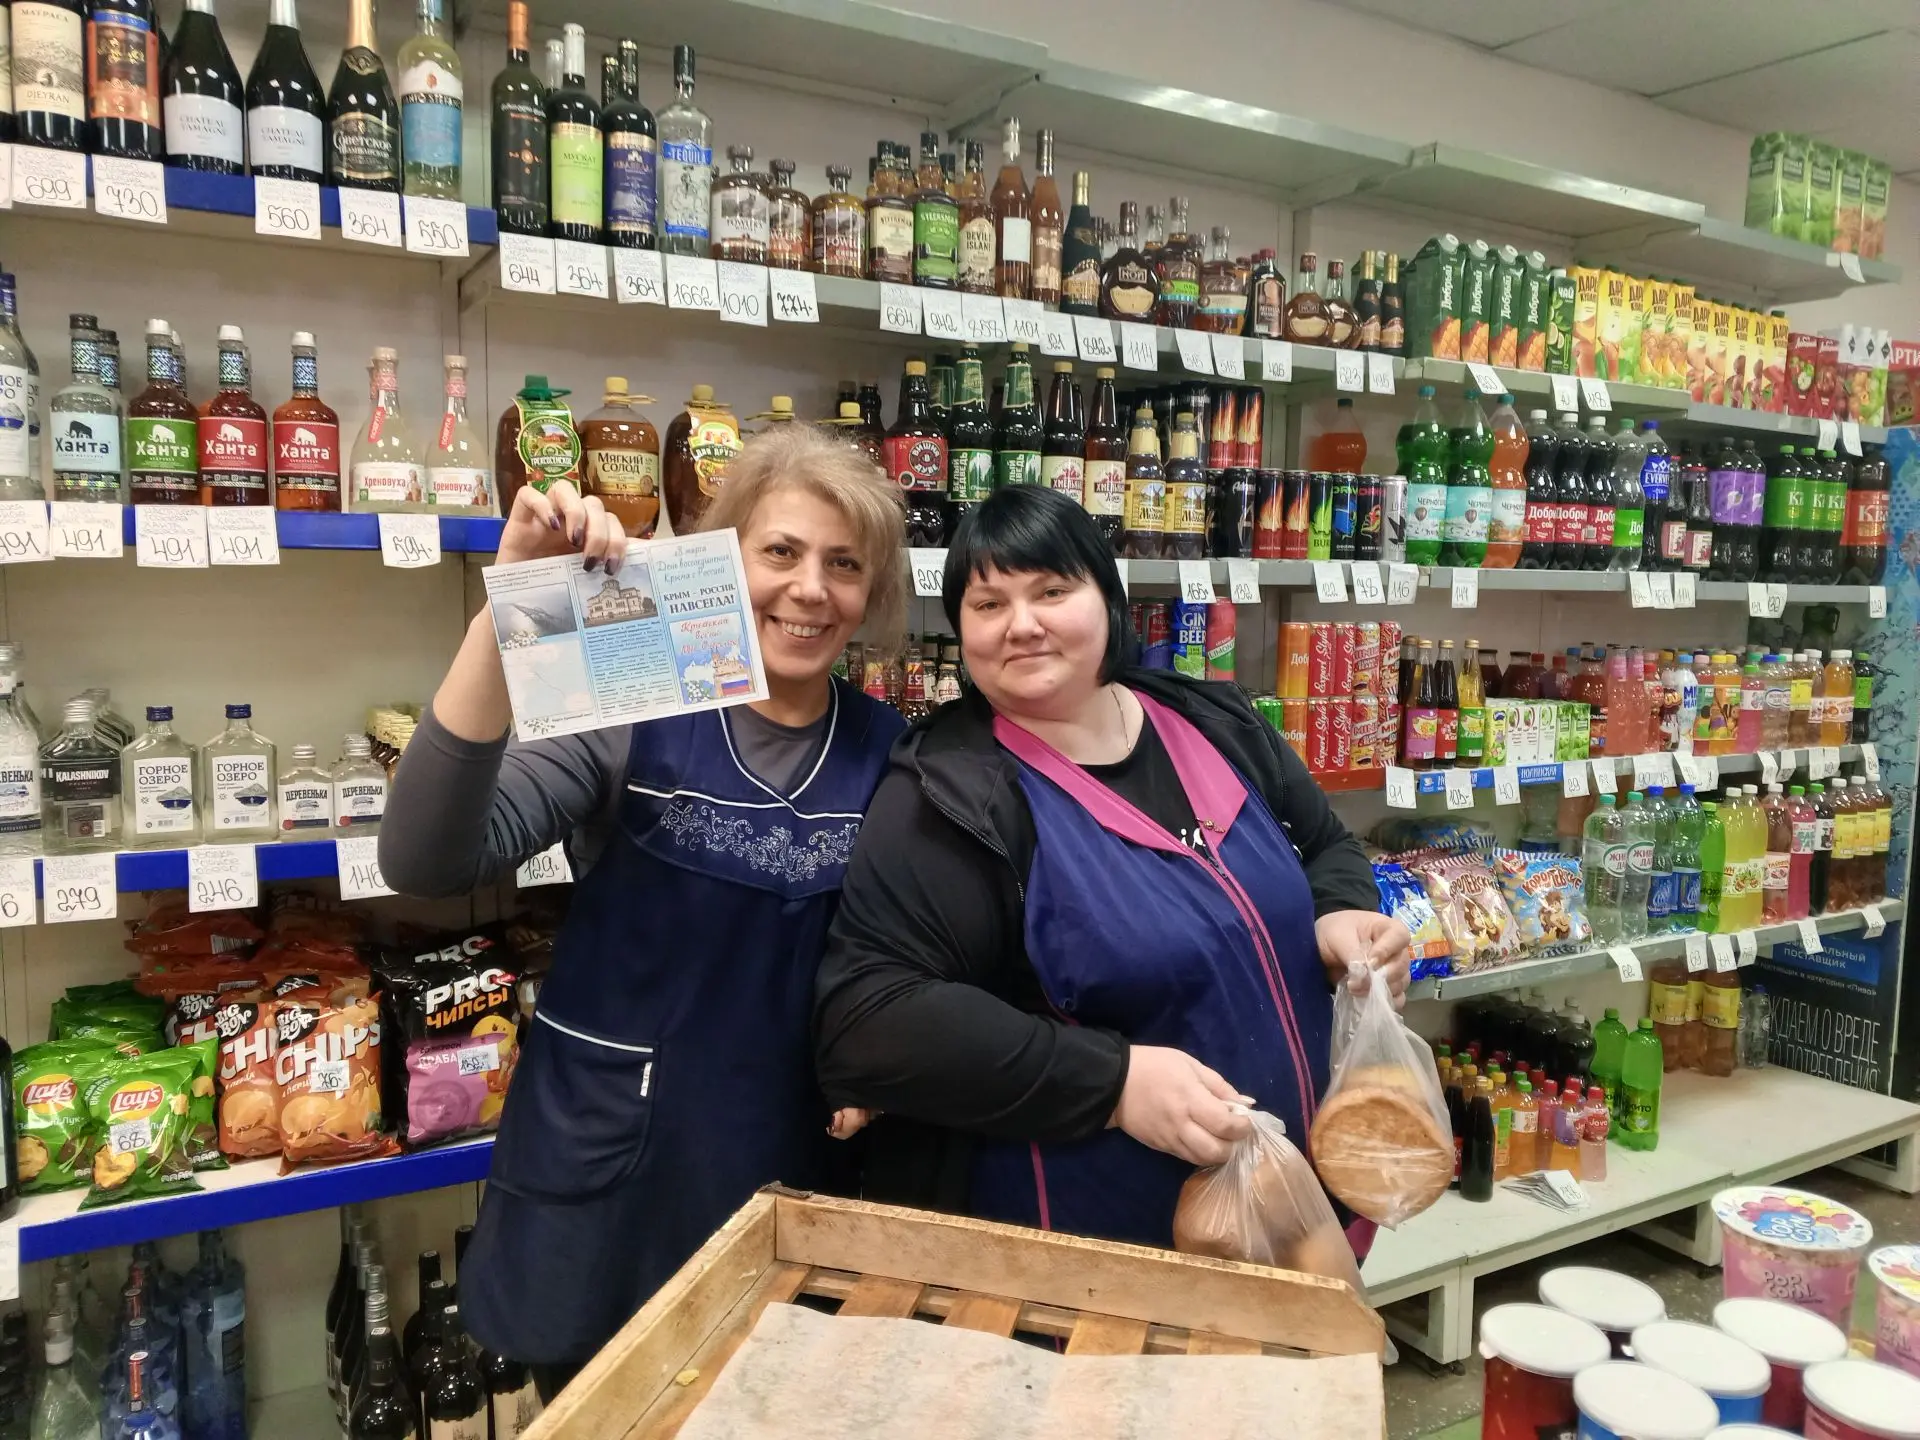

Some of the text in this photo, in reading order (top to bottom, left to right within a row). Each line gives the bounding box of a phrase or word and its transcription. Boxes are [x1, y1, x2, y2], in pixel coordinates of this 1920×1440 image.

[25, 175, 72, 200] 699
[106, 185, 158, 217] 730
[268, 205, 309, 231] 560
[349, 211, 389, 239] 364
[509, 263, 541, 287] 644
[626, 276, 658, 297] 364
[674, 283, 712, 306] 1662
[1441, 265, 1453, 311] Добрый
[1471, 270, 1482, 316] Добрый
[1500, 275, 1512, 320] Добрый
[722, 292, 759, 316] 1010
[1528, 280, 1539, 325] Добрый
[55, 437, 108, 454] Ханта
[136, 440, 189, 458] Ханта
[205, 439, 257, 457] Ханта
[280, 444, 330, 460] Ханта
[364, 476, 406, 488] Хреновуха
[952, 459, 960, 492] БЕЛЫЙ
[960, 452, 968, 498] МЕДВЕДЬ
[433, 481, 473, 493] Хреновуха
[62, 529, 105, 551] 491
[151, 537, 194, 562] 491
[220, 536, 262, 560] 491
[663, 591, 691, 602] КРЫМ
[669, 595, 735, 614] НАВСЕГДА!
[1182, 613, 1206, 627] GIN
[56, 769, 109, 782] KALASHNIKOV
[139, 764, 188, 776] ГОРНОЕ
[216, 762, 264, 773] ГОРНОЕ
[217, 771, 257, 783] ОЗЕРО
[139, 774, 181, 785] ОЗЕРО
[285, 788, 328, 801] ДЕРЕВЕНЬКА
[342, 785, 383, 799] ДЕРЕВЕНЬКА
[57, 886, 101, 912] 279
[197, 878, 243, 903] 246
[1784, 948, 1846, 968] ПОСТАВЩИК
[216, 1004, 239, 1023] BIG
[425, 986, 508, 1029] ЧИПСЫ
[221, 1010, 252, 1038] BON
[1822, 1008, 1831, 1050] О
[1834, 1012, 1881, 1065] ВРЕДЕ
[113, 1086, 160, 1112] Lay's
[118, 1132, 145, 1151] 68
[1761, 1216, 1787, 1238] POP
[1763, 1271, 1802, 1288] POP
